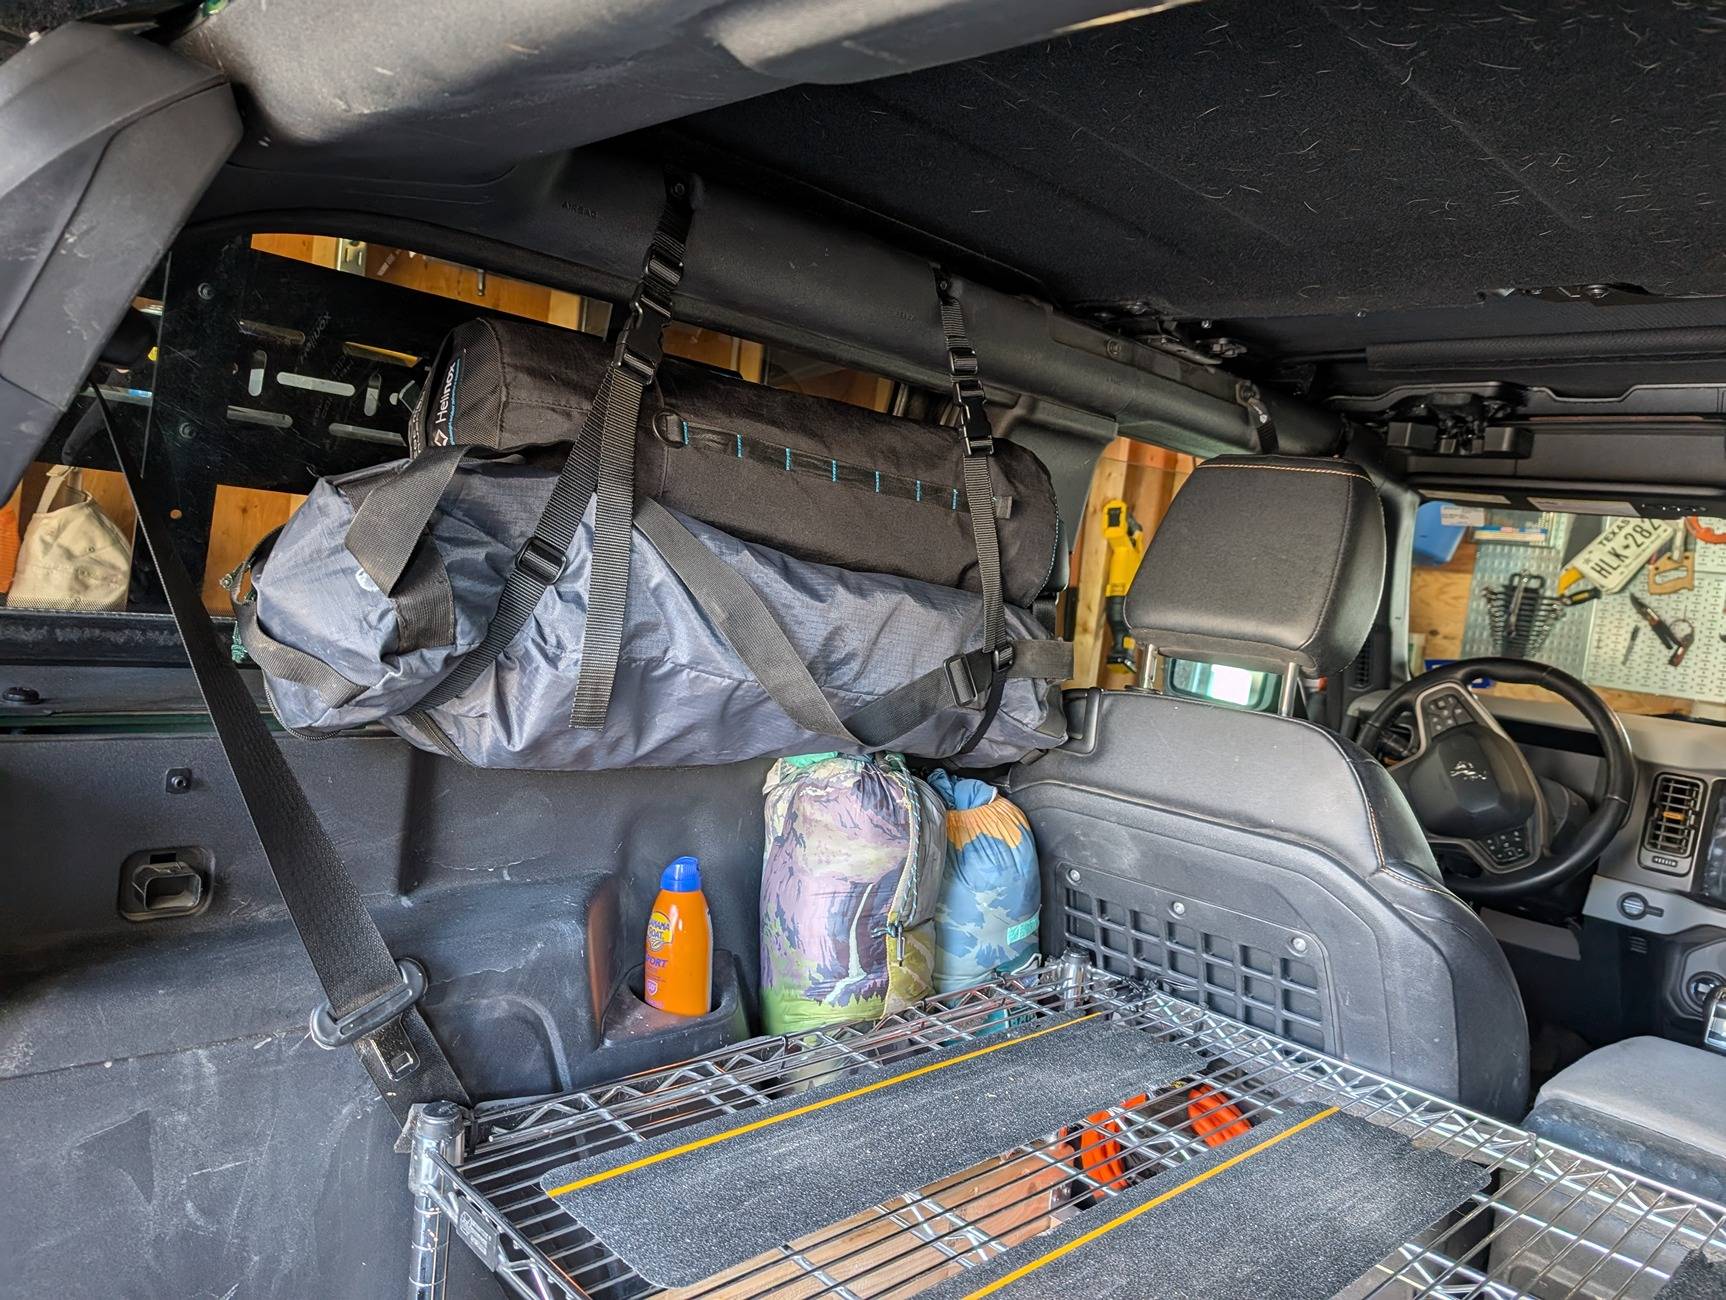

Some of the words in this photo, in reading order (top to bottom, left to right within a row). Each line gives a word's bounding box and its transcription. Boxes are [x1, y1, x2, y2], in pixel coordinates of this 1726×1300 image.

[435, 362, 456, 424] Helinox
[1598, 518, 1631, 547] TEXAS
[646, 955, 668, 968] PORT
